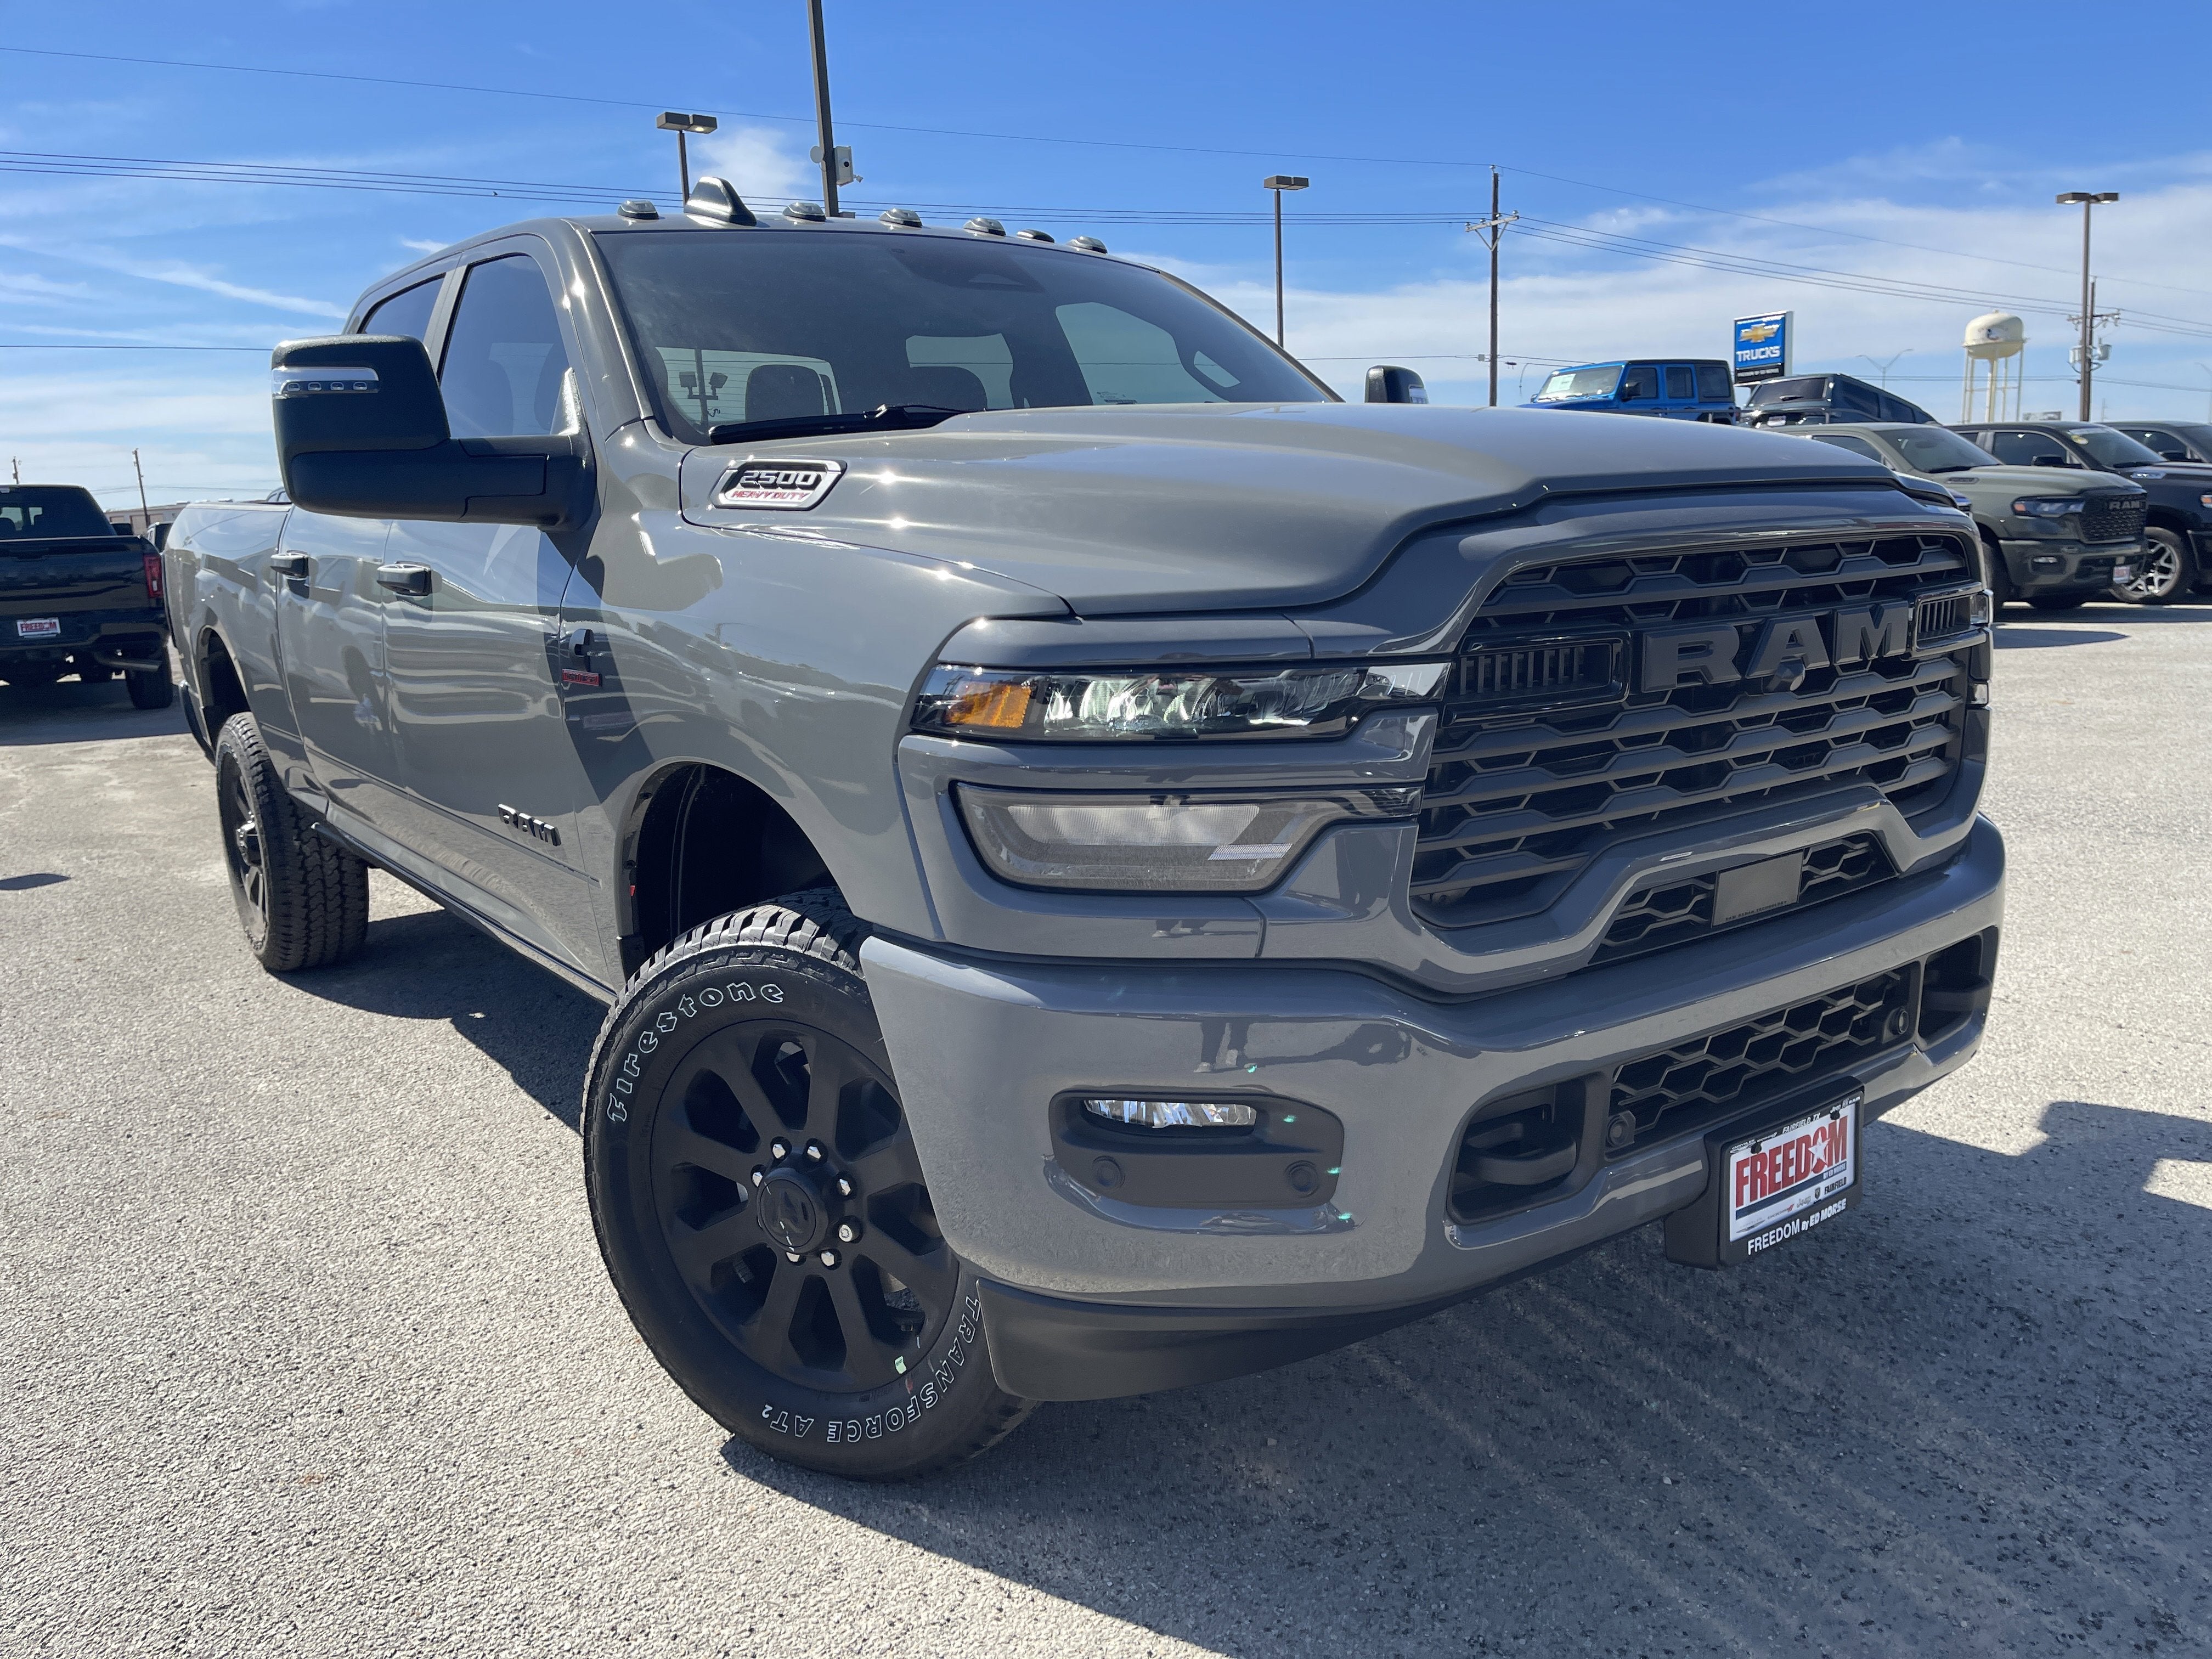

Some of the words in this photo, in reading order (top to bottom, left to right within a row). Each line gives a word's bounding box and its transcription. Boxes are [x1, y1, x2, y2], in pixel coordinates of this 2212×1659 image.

[1736, 346, 1781, 362] TRUCKS
[740, 470, 821, 489] 2500
[2109, 500, 2140, 510] RAM
[1642, 600, 1908, 693] RAM
[607, 981, 784, 1122] Firestone
[1813, 1112, 1821, 1121] TX
[1735, 1115, 1848, 1208] FREEDOM
[1748, 1218, 1799, 1256] FREEDOM
[1809, 1212, 1820, 1227] ED
[1820, 1198, 1847, 1221] MORSE
[827, 1296, 981, 1443] TRANSFORCE
